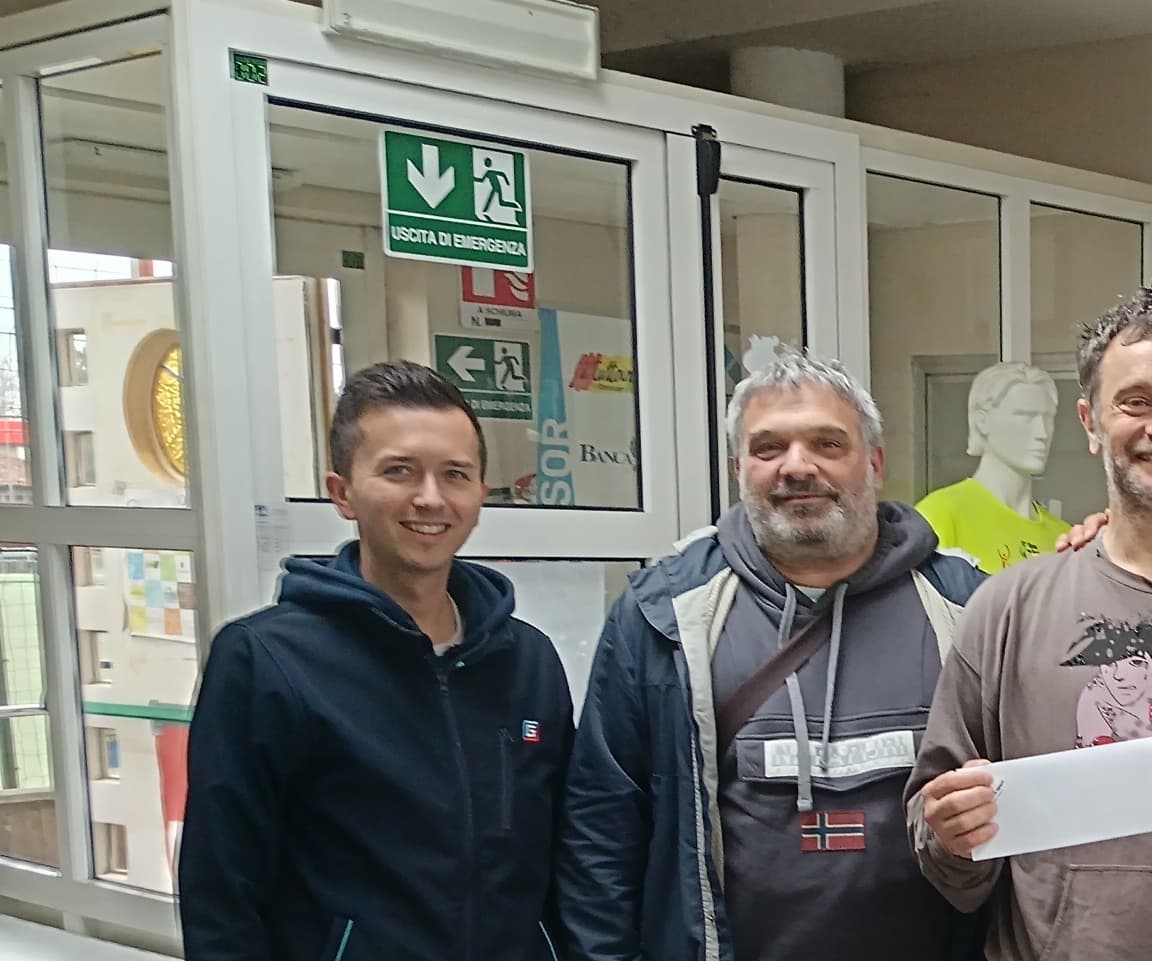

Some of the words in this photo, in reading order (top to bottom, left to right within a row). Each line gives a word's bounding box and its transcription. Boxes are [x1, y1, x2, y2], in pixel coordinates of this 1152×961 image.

[391, 226, 437, 245] USCITA
[438, 232, 452, 247] DI
[453, 233, 527, 256] EMERGENZA
[580, 443, 637, 465] BANCA
